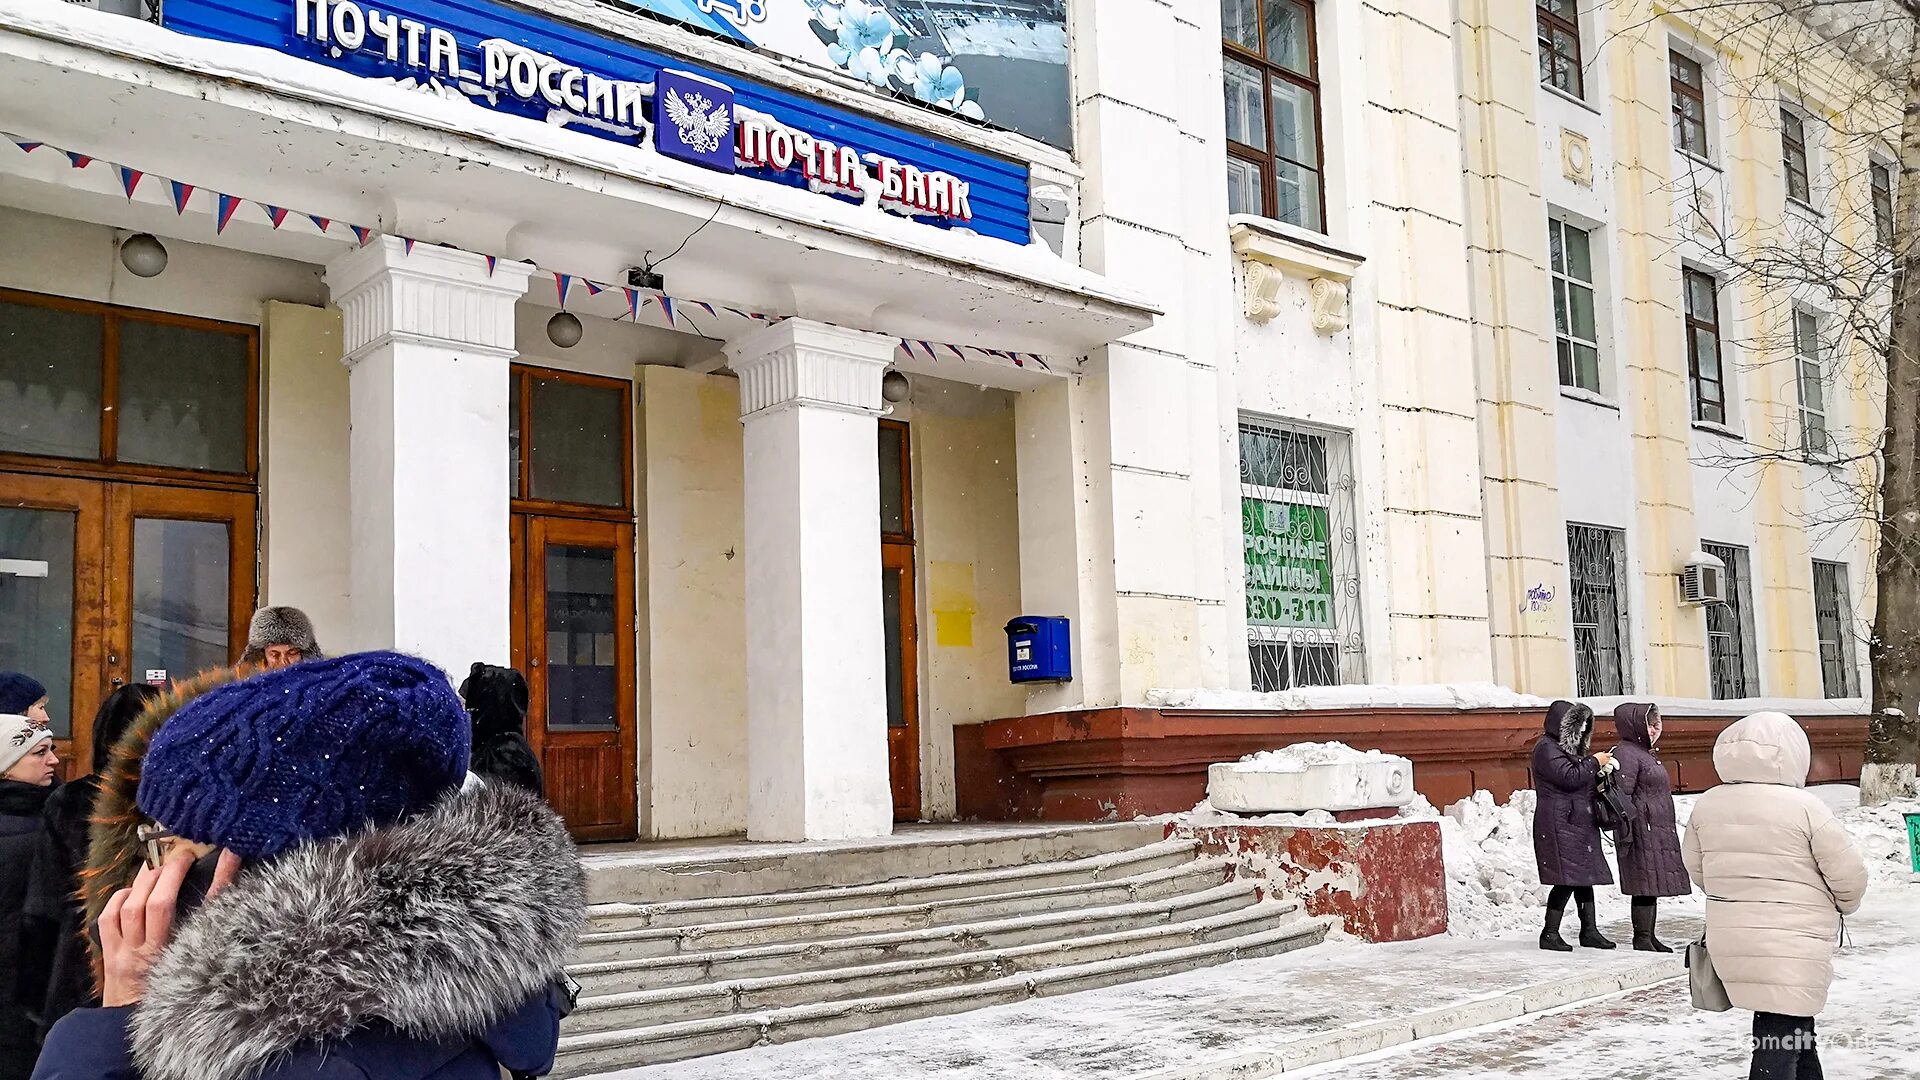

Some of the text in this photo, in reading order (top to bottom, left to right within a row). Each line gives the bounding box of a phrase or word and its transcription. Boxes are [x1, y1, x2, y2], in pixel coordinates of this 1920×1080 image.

[295, 0, 643, 126] ПОЧТА РОССИИ
[740, 119, 973, 222] ПОЧТА БАНК
